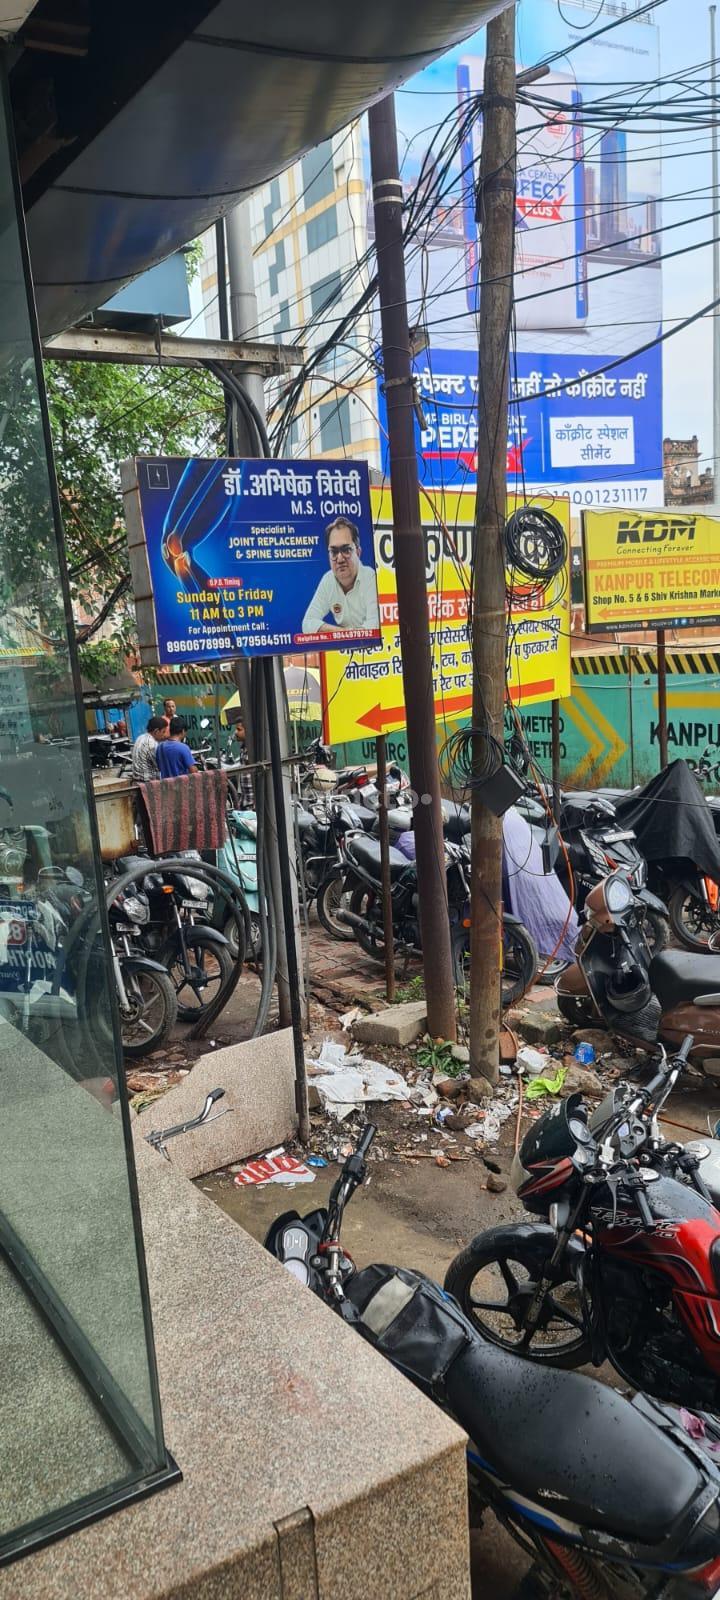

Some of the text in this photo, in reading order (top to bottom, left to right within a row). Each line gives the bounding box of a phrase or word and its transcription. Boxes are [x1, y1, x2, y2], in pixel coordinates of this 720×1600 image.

[515, 178, 566, 200] FECT
[524, 202, 553, 217] PLUS
[619, 373, 648, 399] नहीं
[442, 413, 477, 425] BIRLA
[421, 427, 528, 449] PERFT
[597, 424, 629, 441] स्पेशल
[580, 444, 612, 461] सीमेंट
[316, 470, 361, 497] त्रिवेदी
[291, 501, 362, 517] M.S. (Ortho)
[251, 525, 295, 535] Specialist in
[616, 517, 697, 544] KDM
[229, 536, 320, 548] JOINT REPLACEMENT
[616, 543, 694, 555] Connecting Forever
[236, 548, 313, 559] & SPINE SURGERY
[594, 572, 654, 592] KANPUR
[176, 588, 273, 604] Sunday to Friday
[592, 595, 612, 605] Shop
[614, 594, 627, 604] No.
[629, 593, 634, 602] 5
[644, 592, 649, 602] 6
[650, 591, 667, 602] Shiv
[669, 590, 697, 600] Krishna
[700, 588, 720, 598] Mark
[190, 605, 263, 620] 11 AM to 3 PM
[188, 626, 201, 634] For
[202, 624, 250, 635] Appointment
[346, 661, 391, 680] मोबाइल
[523, 640, 549, 659] फुटकर
[650, 720, 720, 747] KANPU
[362, 741, 406, 762] UPRC
